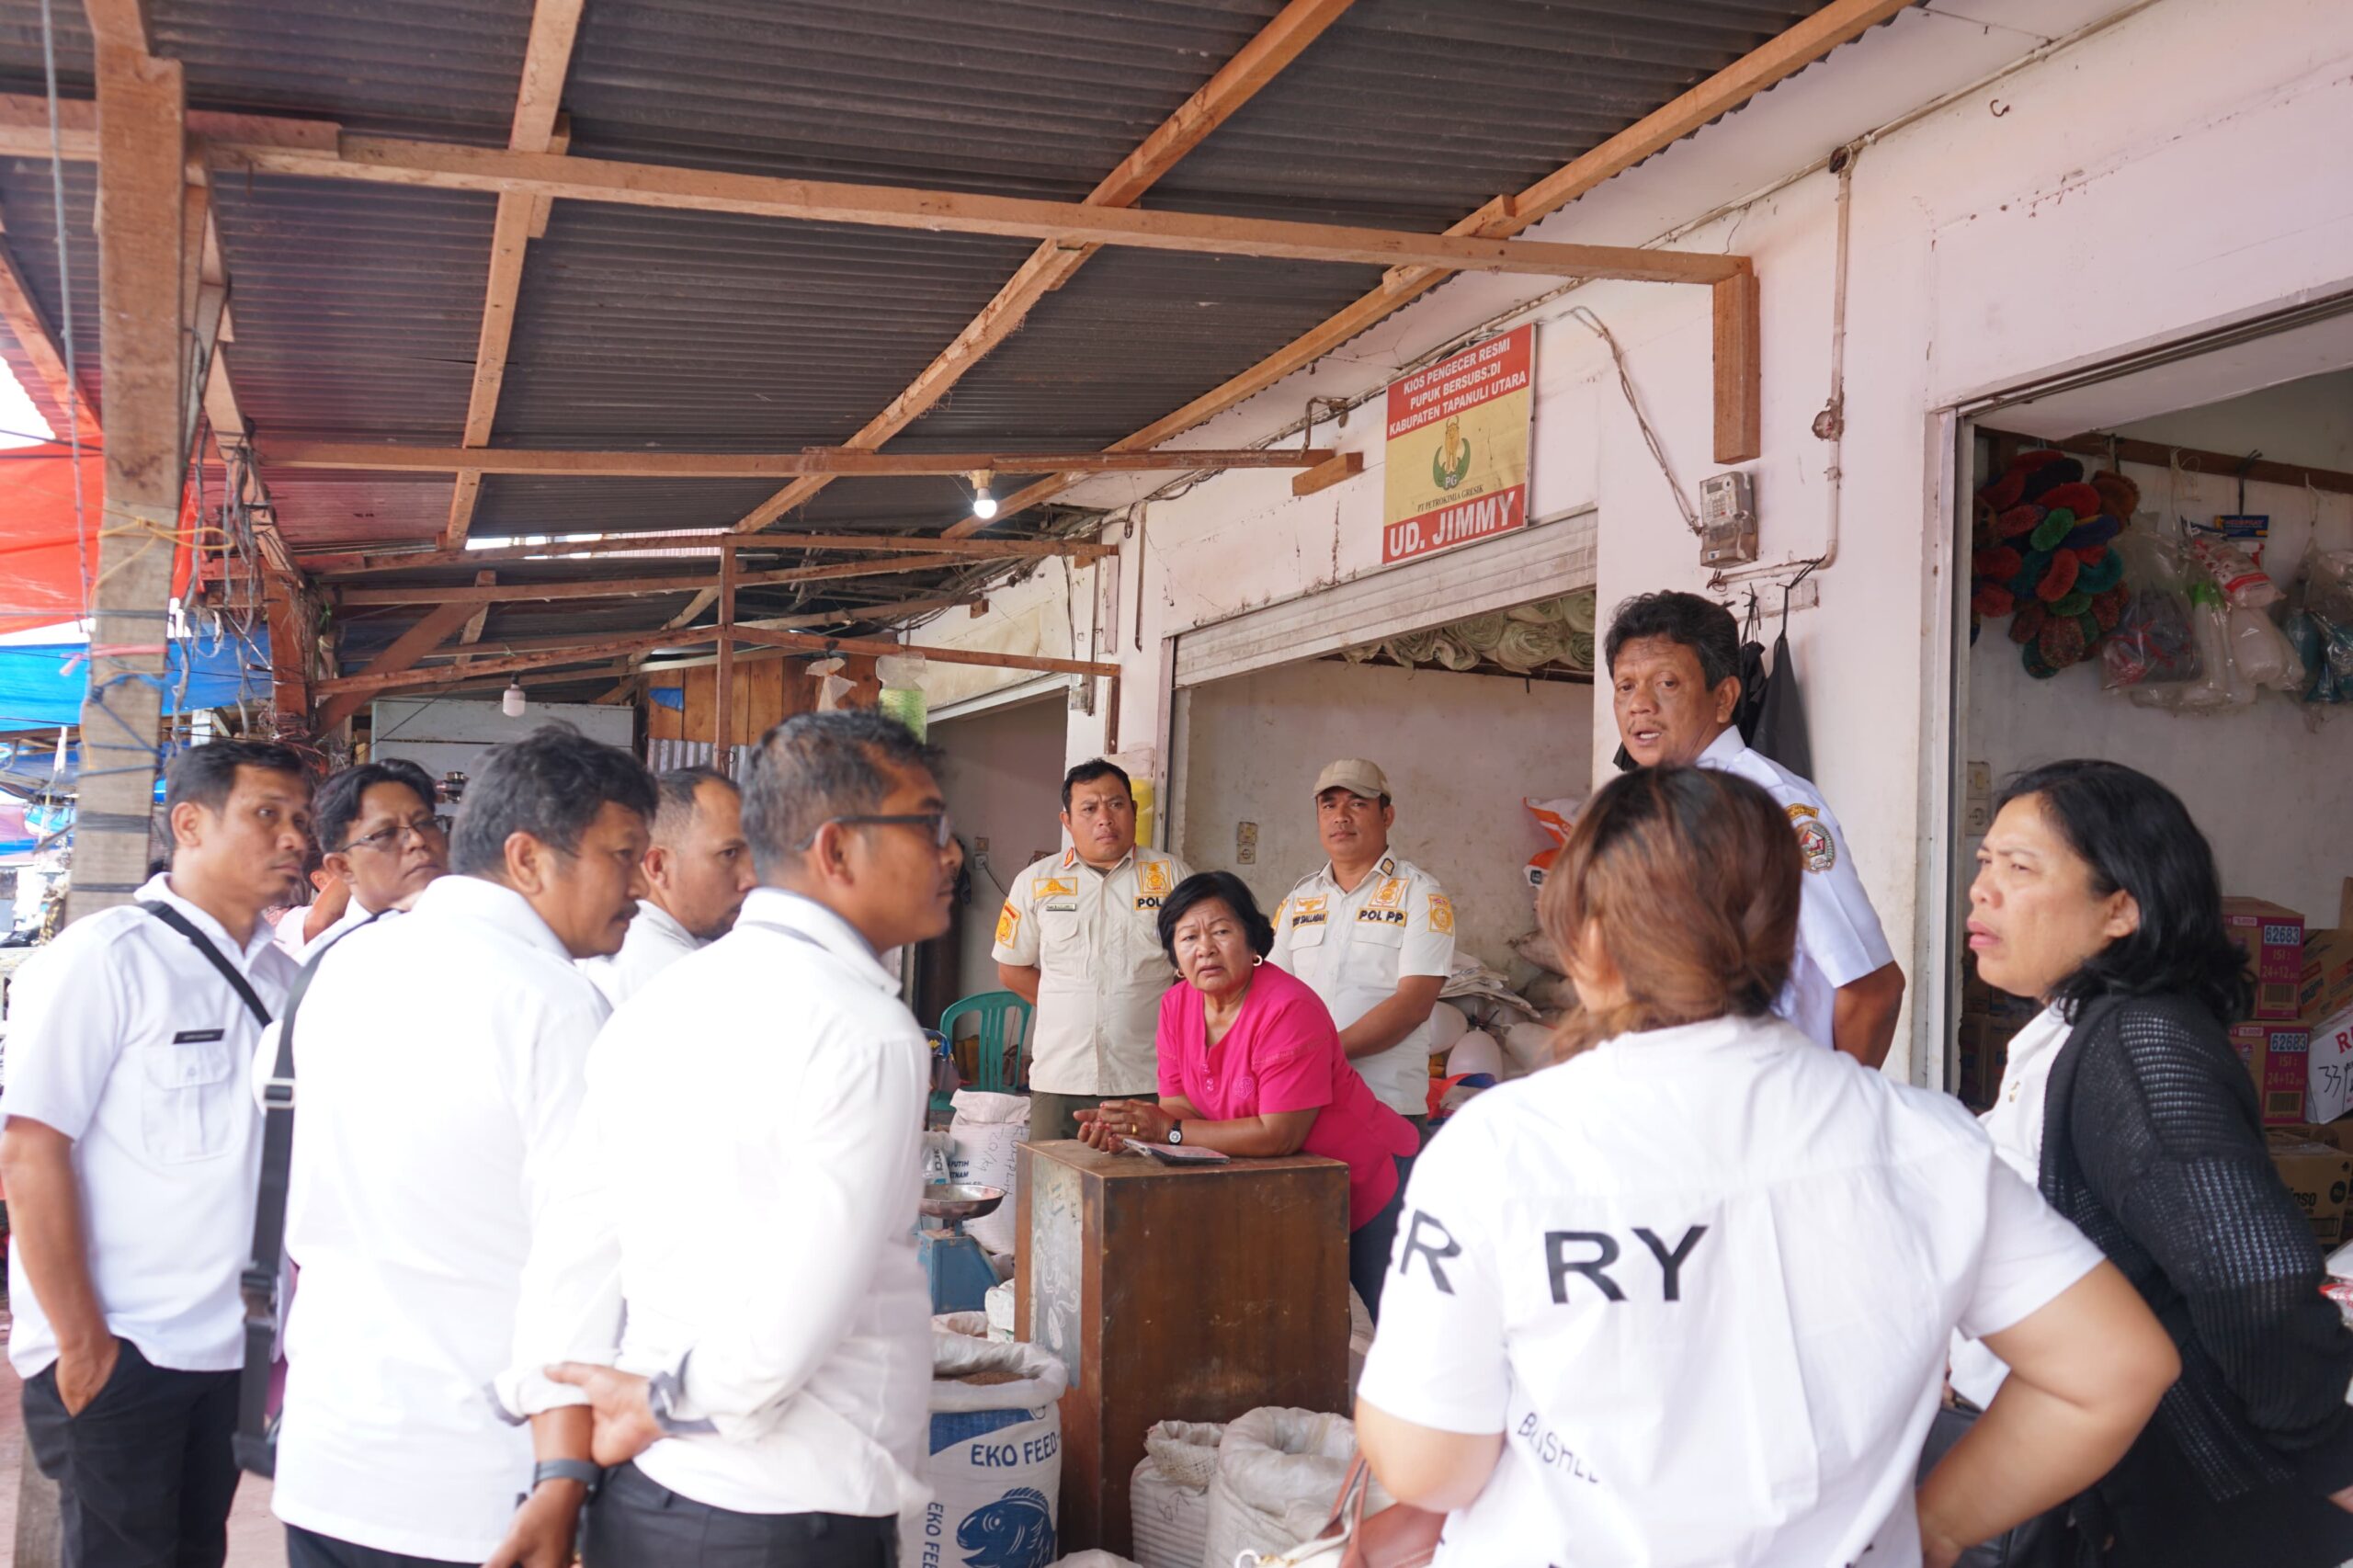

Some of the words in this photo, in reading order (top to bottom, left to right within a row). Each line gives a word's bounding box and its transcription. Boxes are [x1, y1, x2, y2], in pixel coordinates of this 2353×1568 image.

[1404, 377, 1426, 395] KIOS
[1427, 357, 1477, 384] PENGECER
[1479, 337, 1510, 359] RESMI
[1389, 407, 1440, 436] KABUPATEN
[1442, 387, 1489, 416] TAPANULI
[1491, 370, 1526, 396] UTARA
[1410, 389, 1441, 410] PUPUK
[1445, 474, 1458, 488] PG
[1417, 502, 1424, 513] PT
[1425, 492, 1461, 511] PETROKIMIA
[1461, 484, 1484, 500] GRESIK
[1389, 521, 1425, 558] UD.
[1432, 491, 1515, 545] JIMMY
[1137, 897, 1162, 908] POL
[1358, 910, 1382, 922] POL
[1385, 911, 1404, 924] PP
[2265, 926, 2300, 944] 62683
[2272, 1034, 2307, 1051] 62683
[1399, 1209, 1462, 1296] R
[1543, 1225, 1709, 1305] RY
[971, 1444, 1017, 1467] EKO
[926, 1502, 944, 1537] EKO
